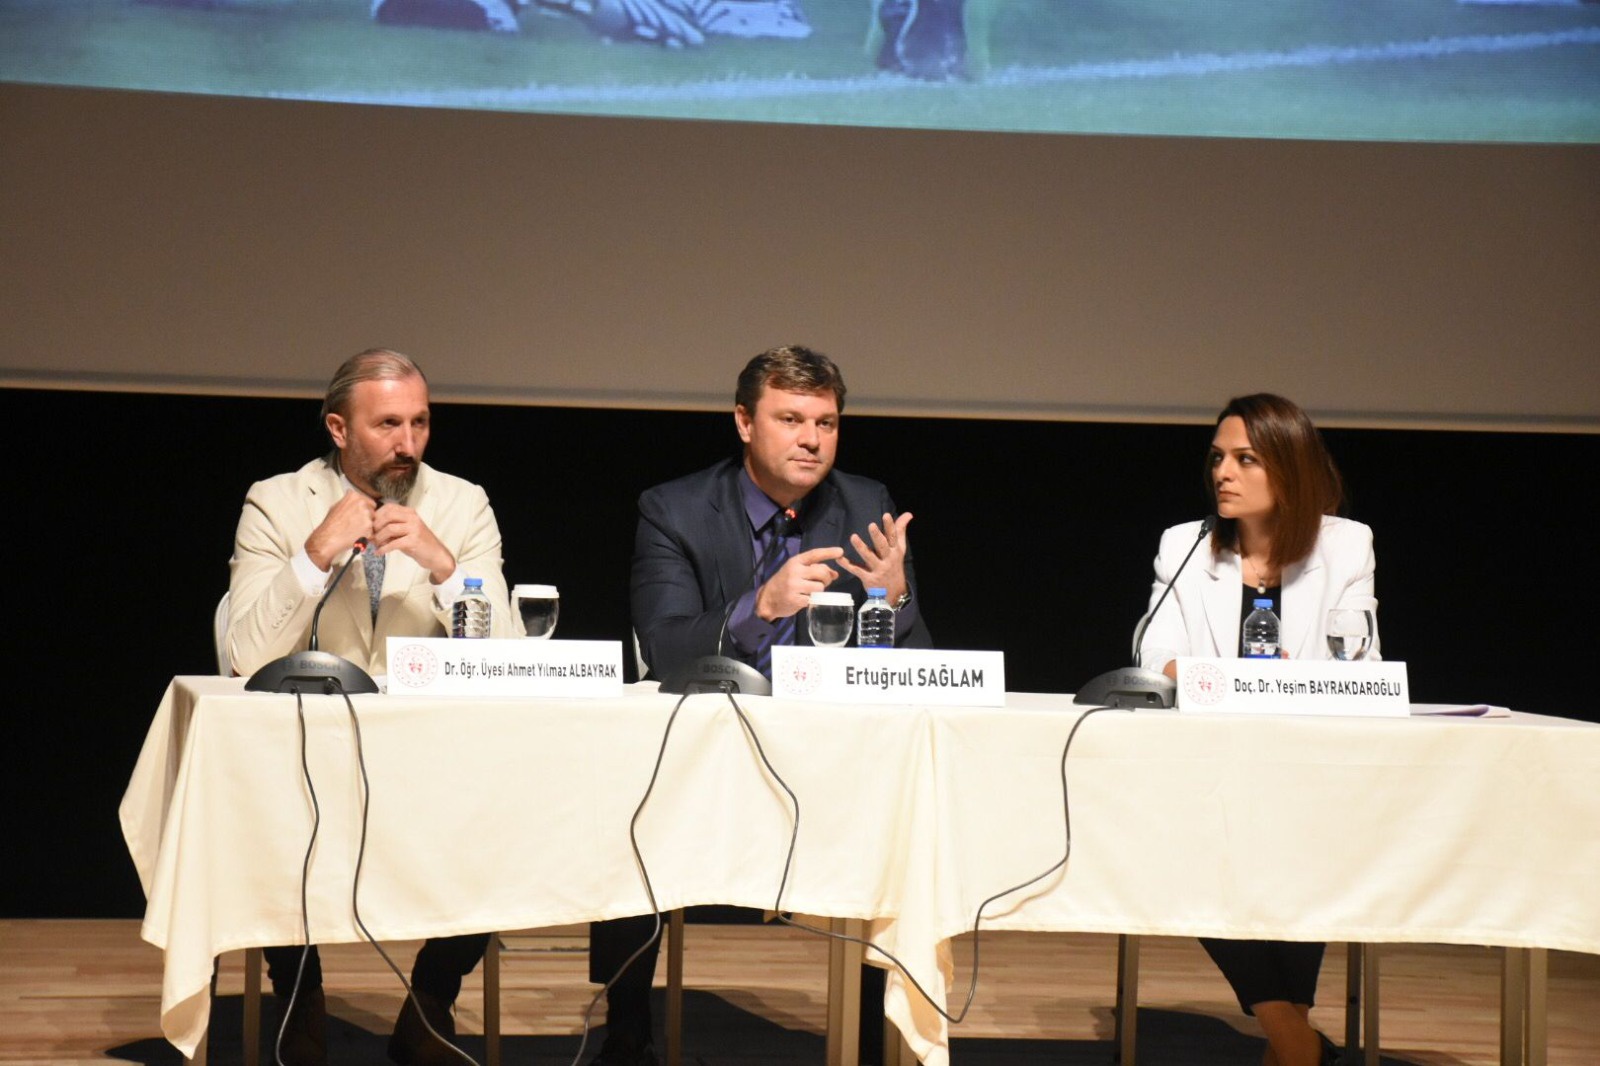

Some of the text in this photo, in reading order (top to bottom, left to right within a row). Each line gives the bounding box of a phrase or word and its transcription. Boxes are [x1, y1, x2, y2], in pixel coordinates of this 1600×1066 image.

[444, 658, 617, 680] Dr. Öğr. Üyesi Ahmet Yılmaz ALBAYRAK
[703, 664, 740, 675] BOSCH
[845, 664, 984, 690] Ertuğrul SAĞLAM
[1234, 678, 1401, 697] Doç. Dr. Yeşim BAYRAKDAROĞLU
